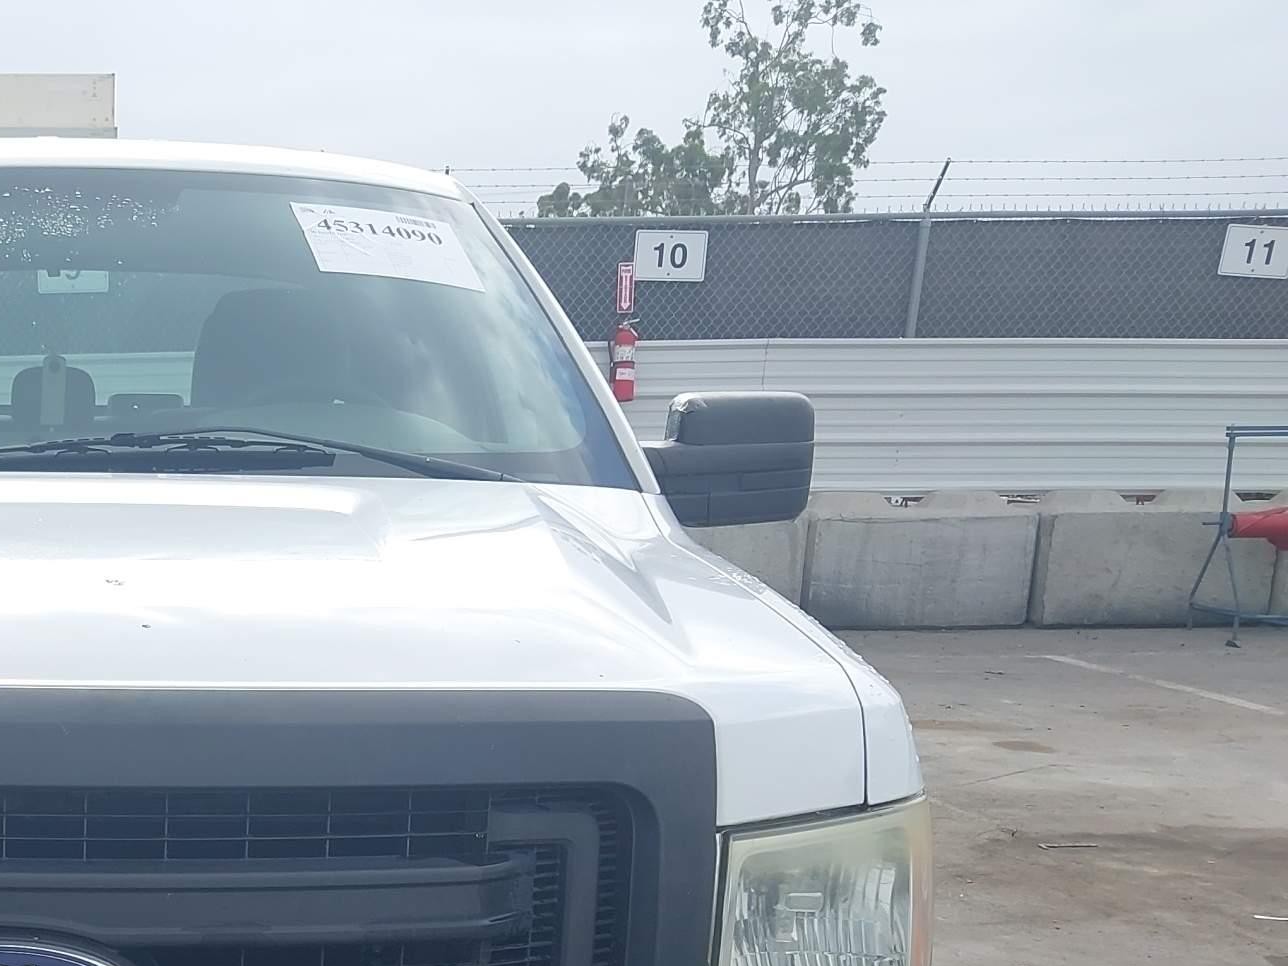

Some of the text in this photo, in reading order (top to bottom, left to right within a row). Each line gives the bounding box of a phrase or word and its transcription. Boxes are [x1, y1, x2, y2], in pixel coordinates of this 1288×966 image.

[317, 218, 443, 246] 45314090
[653, 242, 688, 269] 10
[1244, 238, 1276, 266] 11
